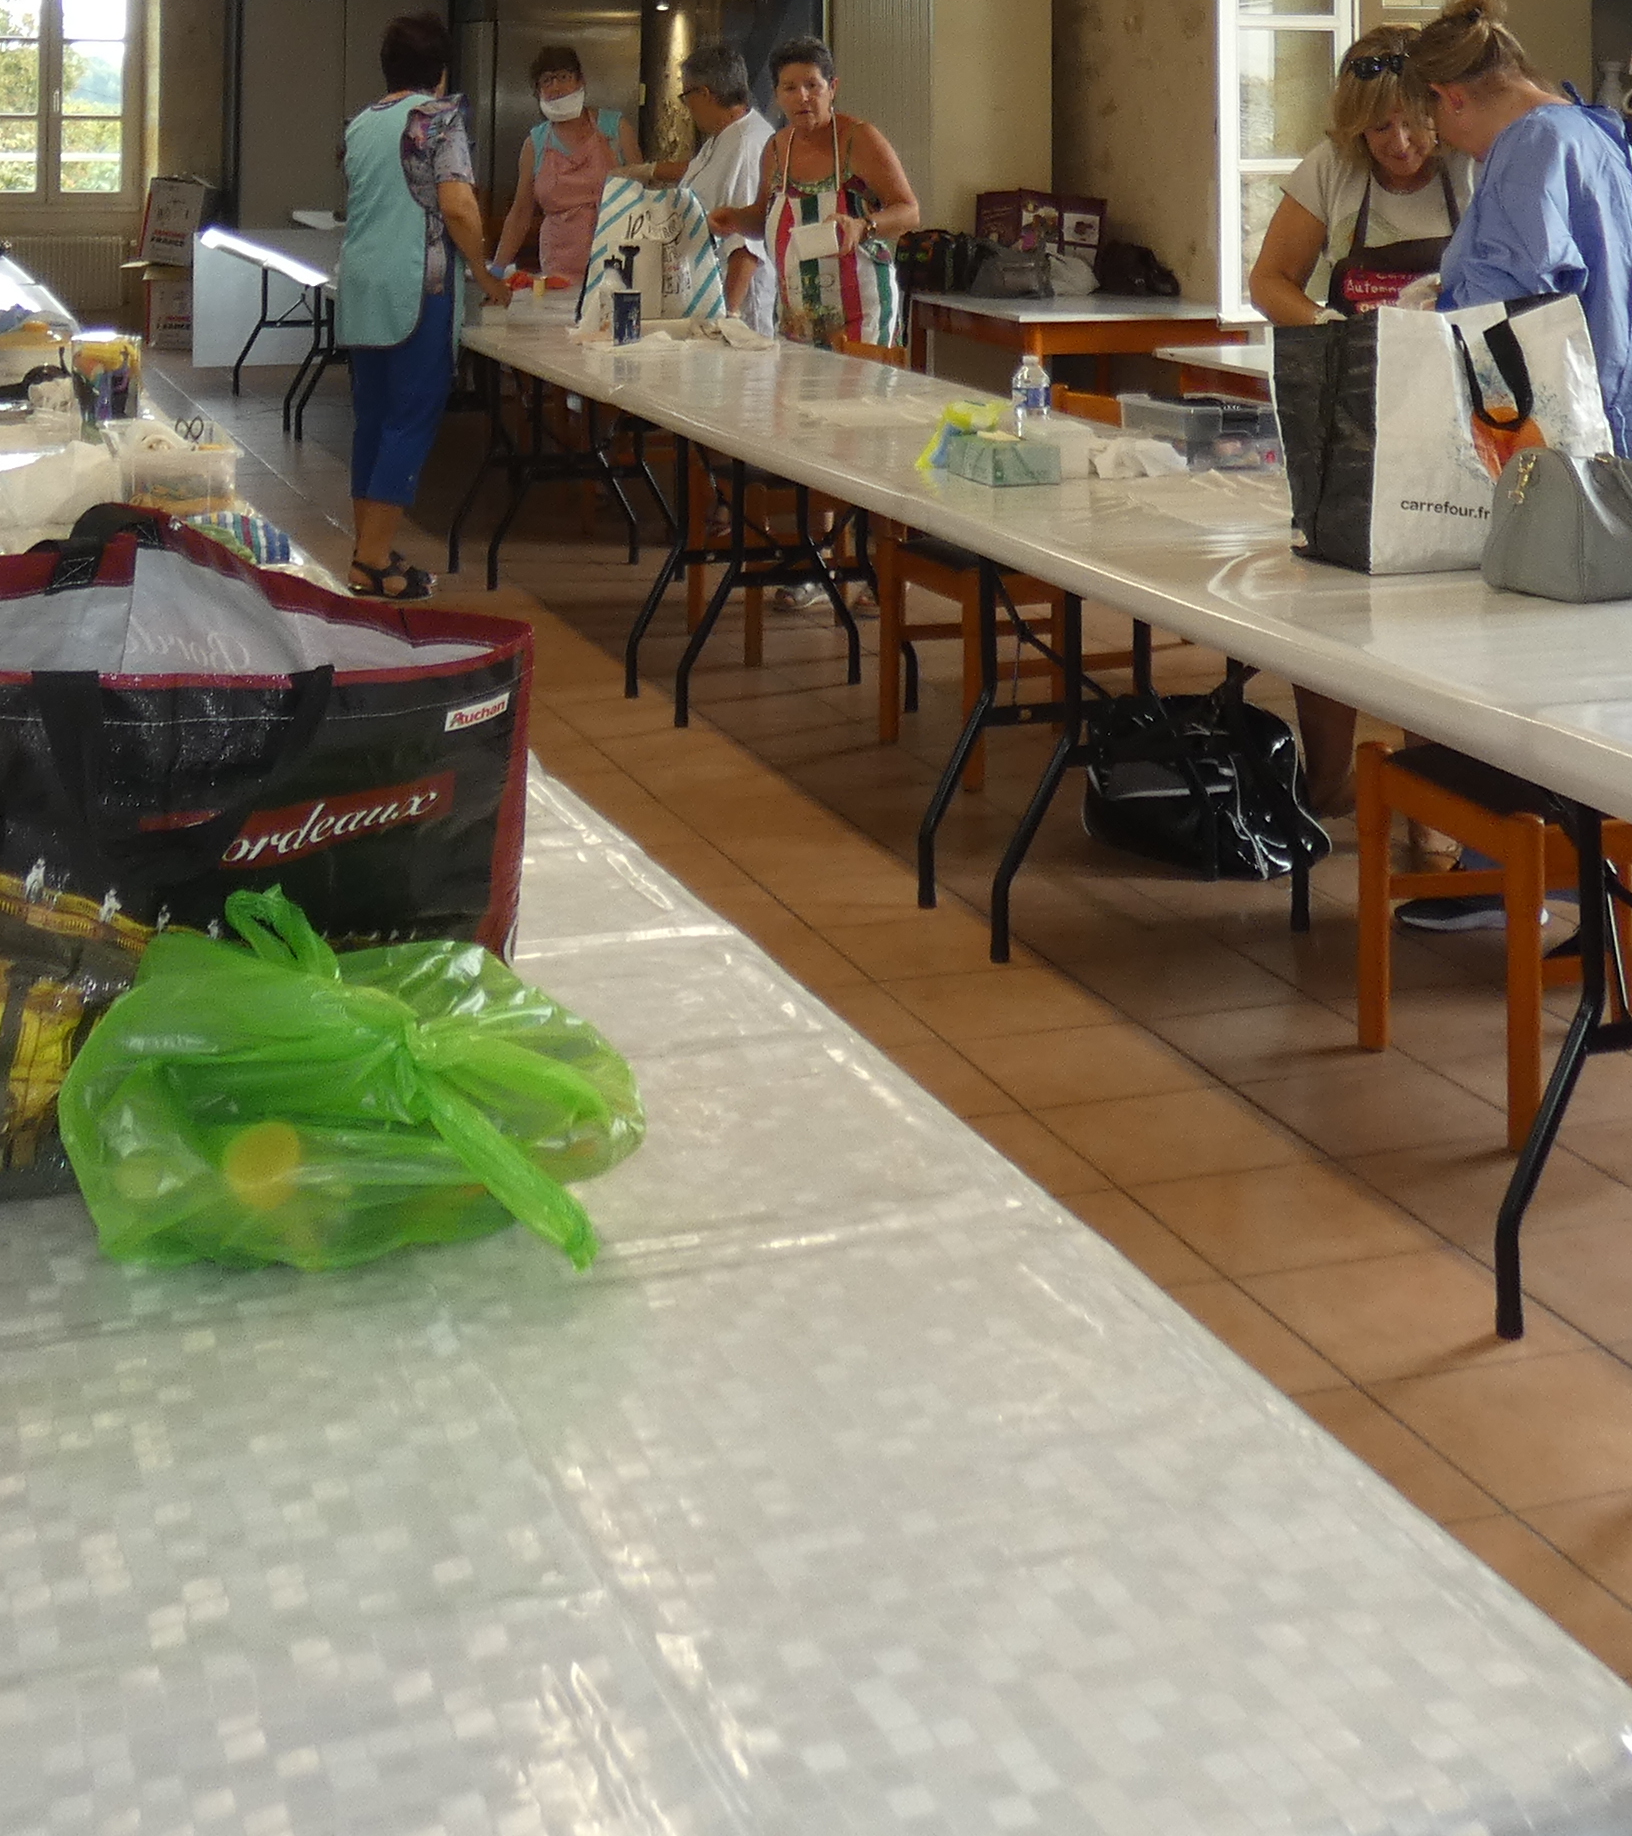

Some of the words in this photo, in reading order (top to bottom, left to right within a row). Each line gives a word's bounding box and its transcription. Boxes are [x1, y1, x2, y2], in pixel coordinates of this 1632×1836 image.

[1400, 500, 1491, 520] carrefour.fr
[449, 700, 506, 728] Auchan
[220, 791, 438, 863] ordeaux
